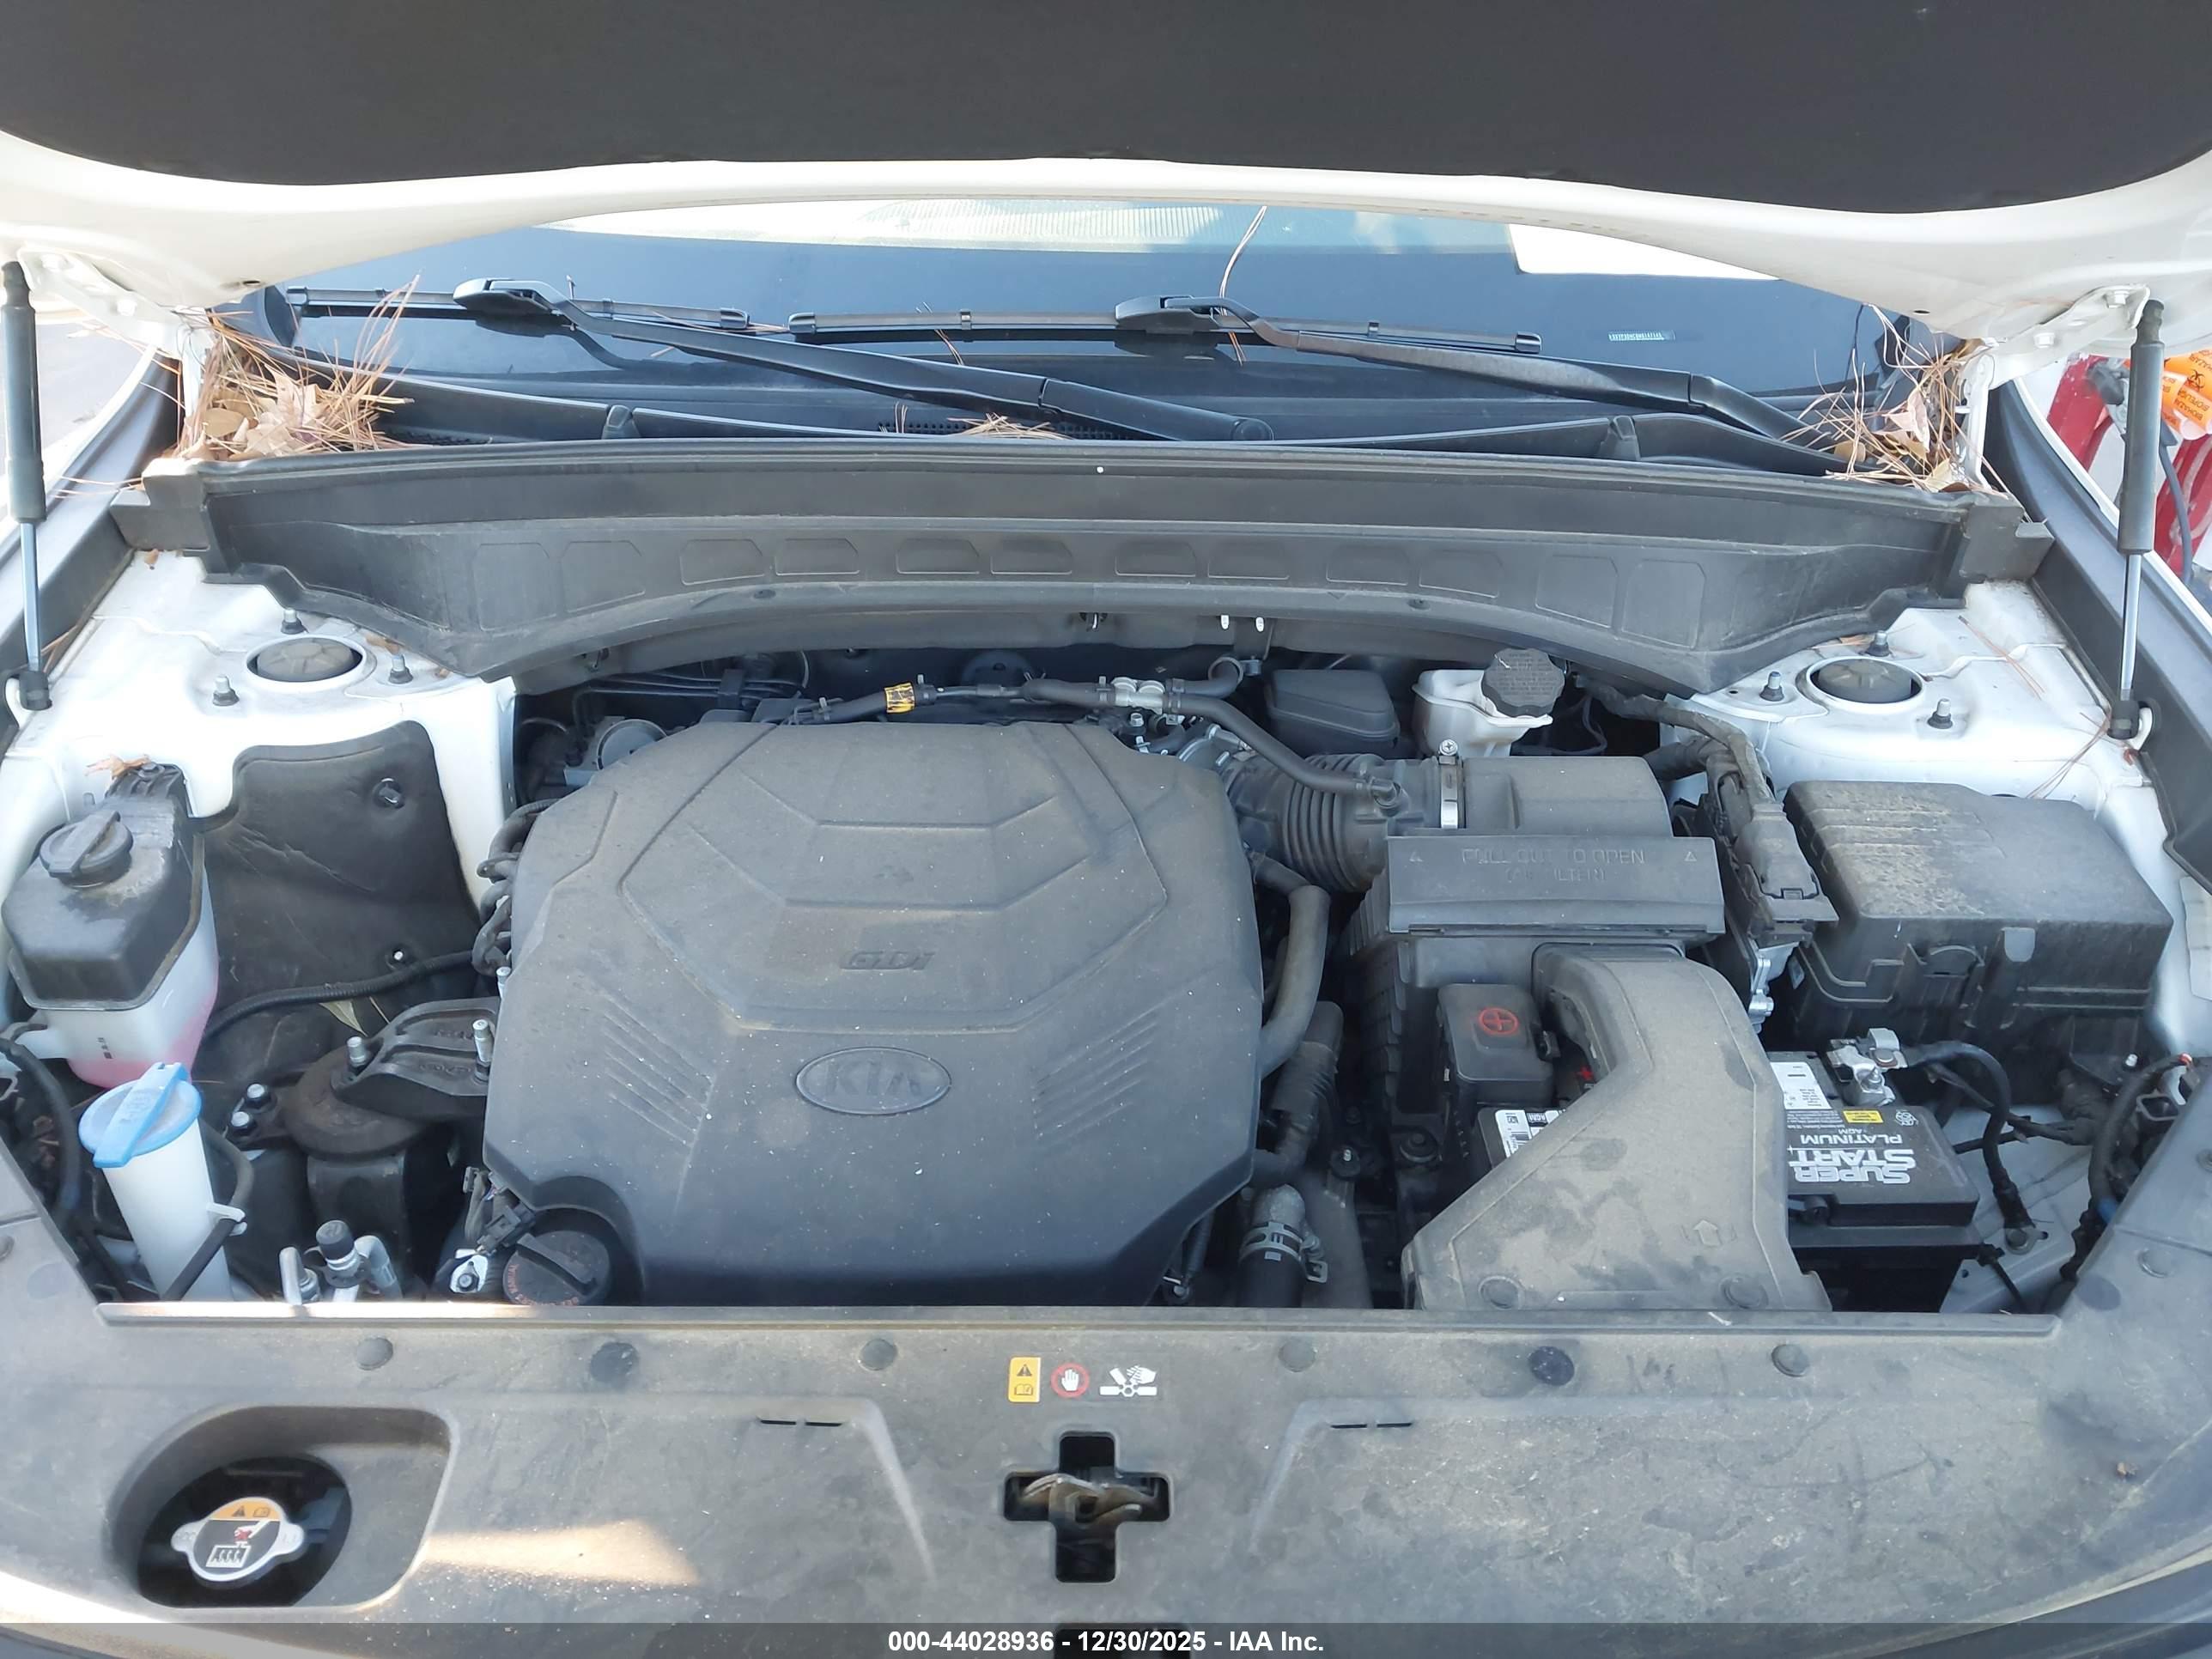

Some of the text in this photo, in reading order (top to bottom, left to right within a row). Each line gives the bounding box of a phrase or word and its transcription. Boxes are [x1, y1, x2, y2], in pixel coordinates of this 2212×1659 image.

[1462, 848, 1511, 865] PULL
[1592, 848, 1645, 865] OPEN
[826, 1060, 921, 1096] KIA
[1800, 1133, 1903, 1145] PLATINUM
[1787, 1148, 1917, 1169] START
[1792, 1165, 1911, 1184] SUPER
